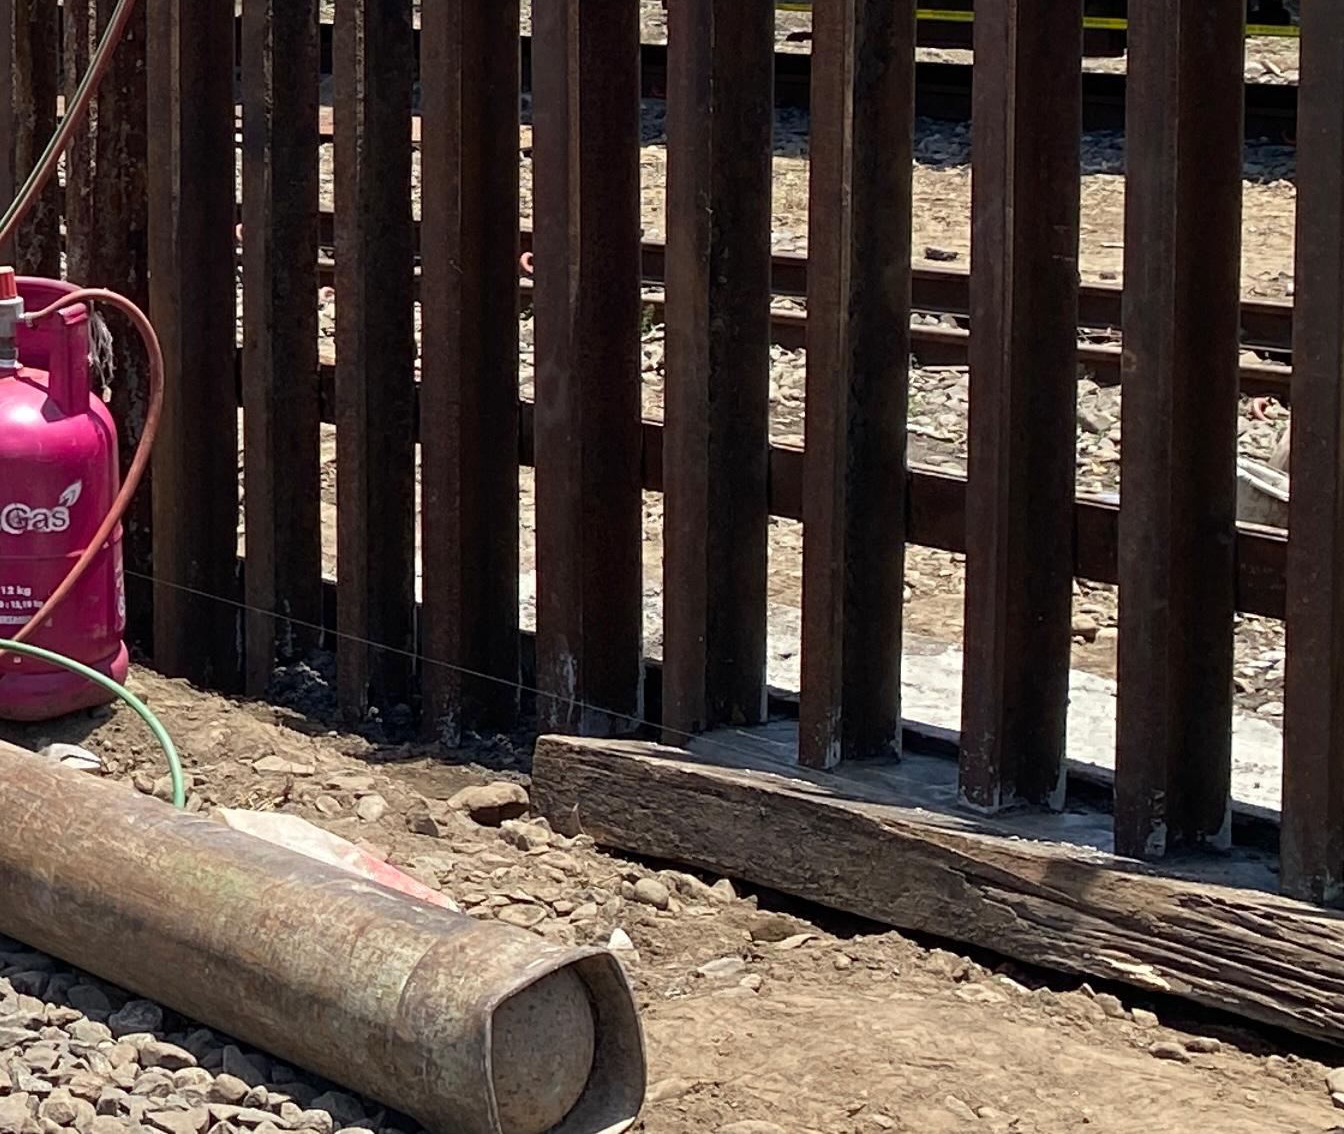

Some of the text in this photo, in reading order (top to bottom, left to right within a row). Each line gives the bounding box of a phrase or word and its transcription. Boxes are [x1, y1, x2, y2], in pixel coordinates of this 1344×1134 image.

[0, 503, 70, 535] Gas
[0, 586, 15, 595] 12
[16, 586, 32, 597] kg
